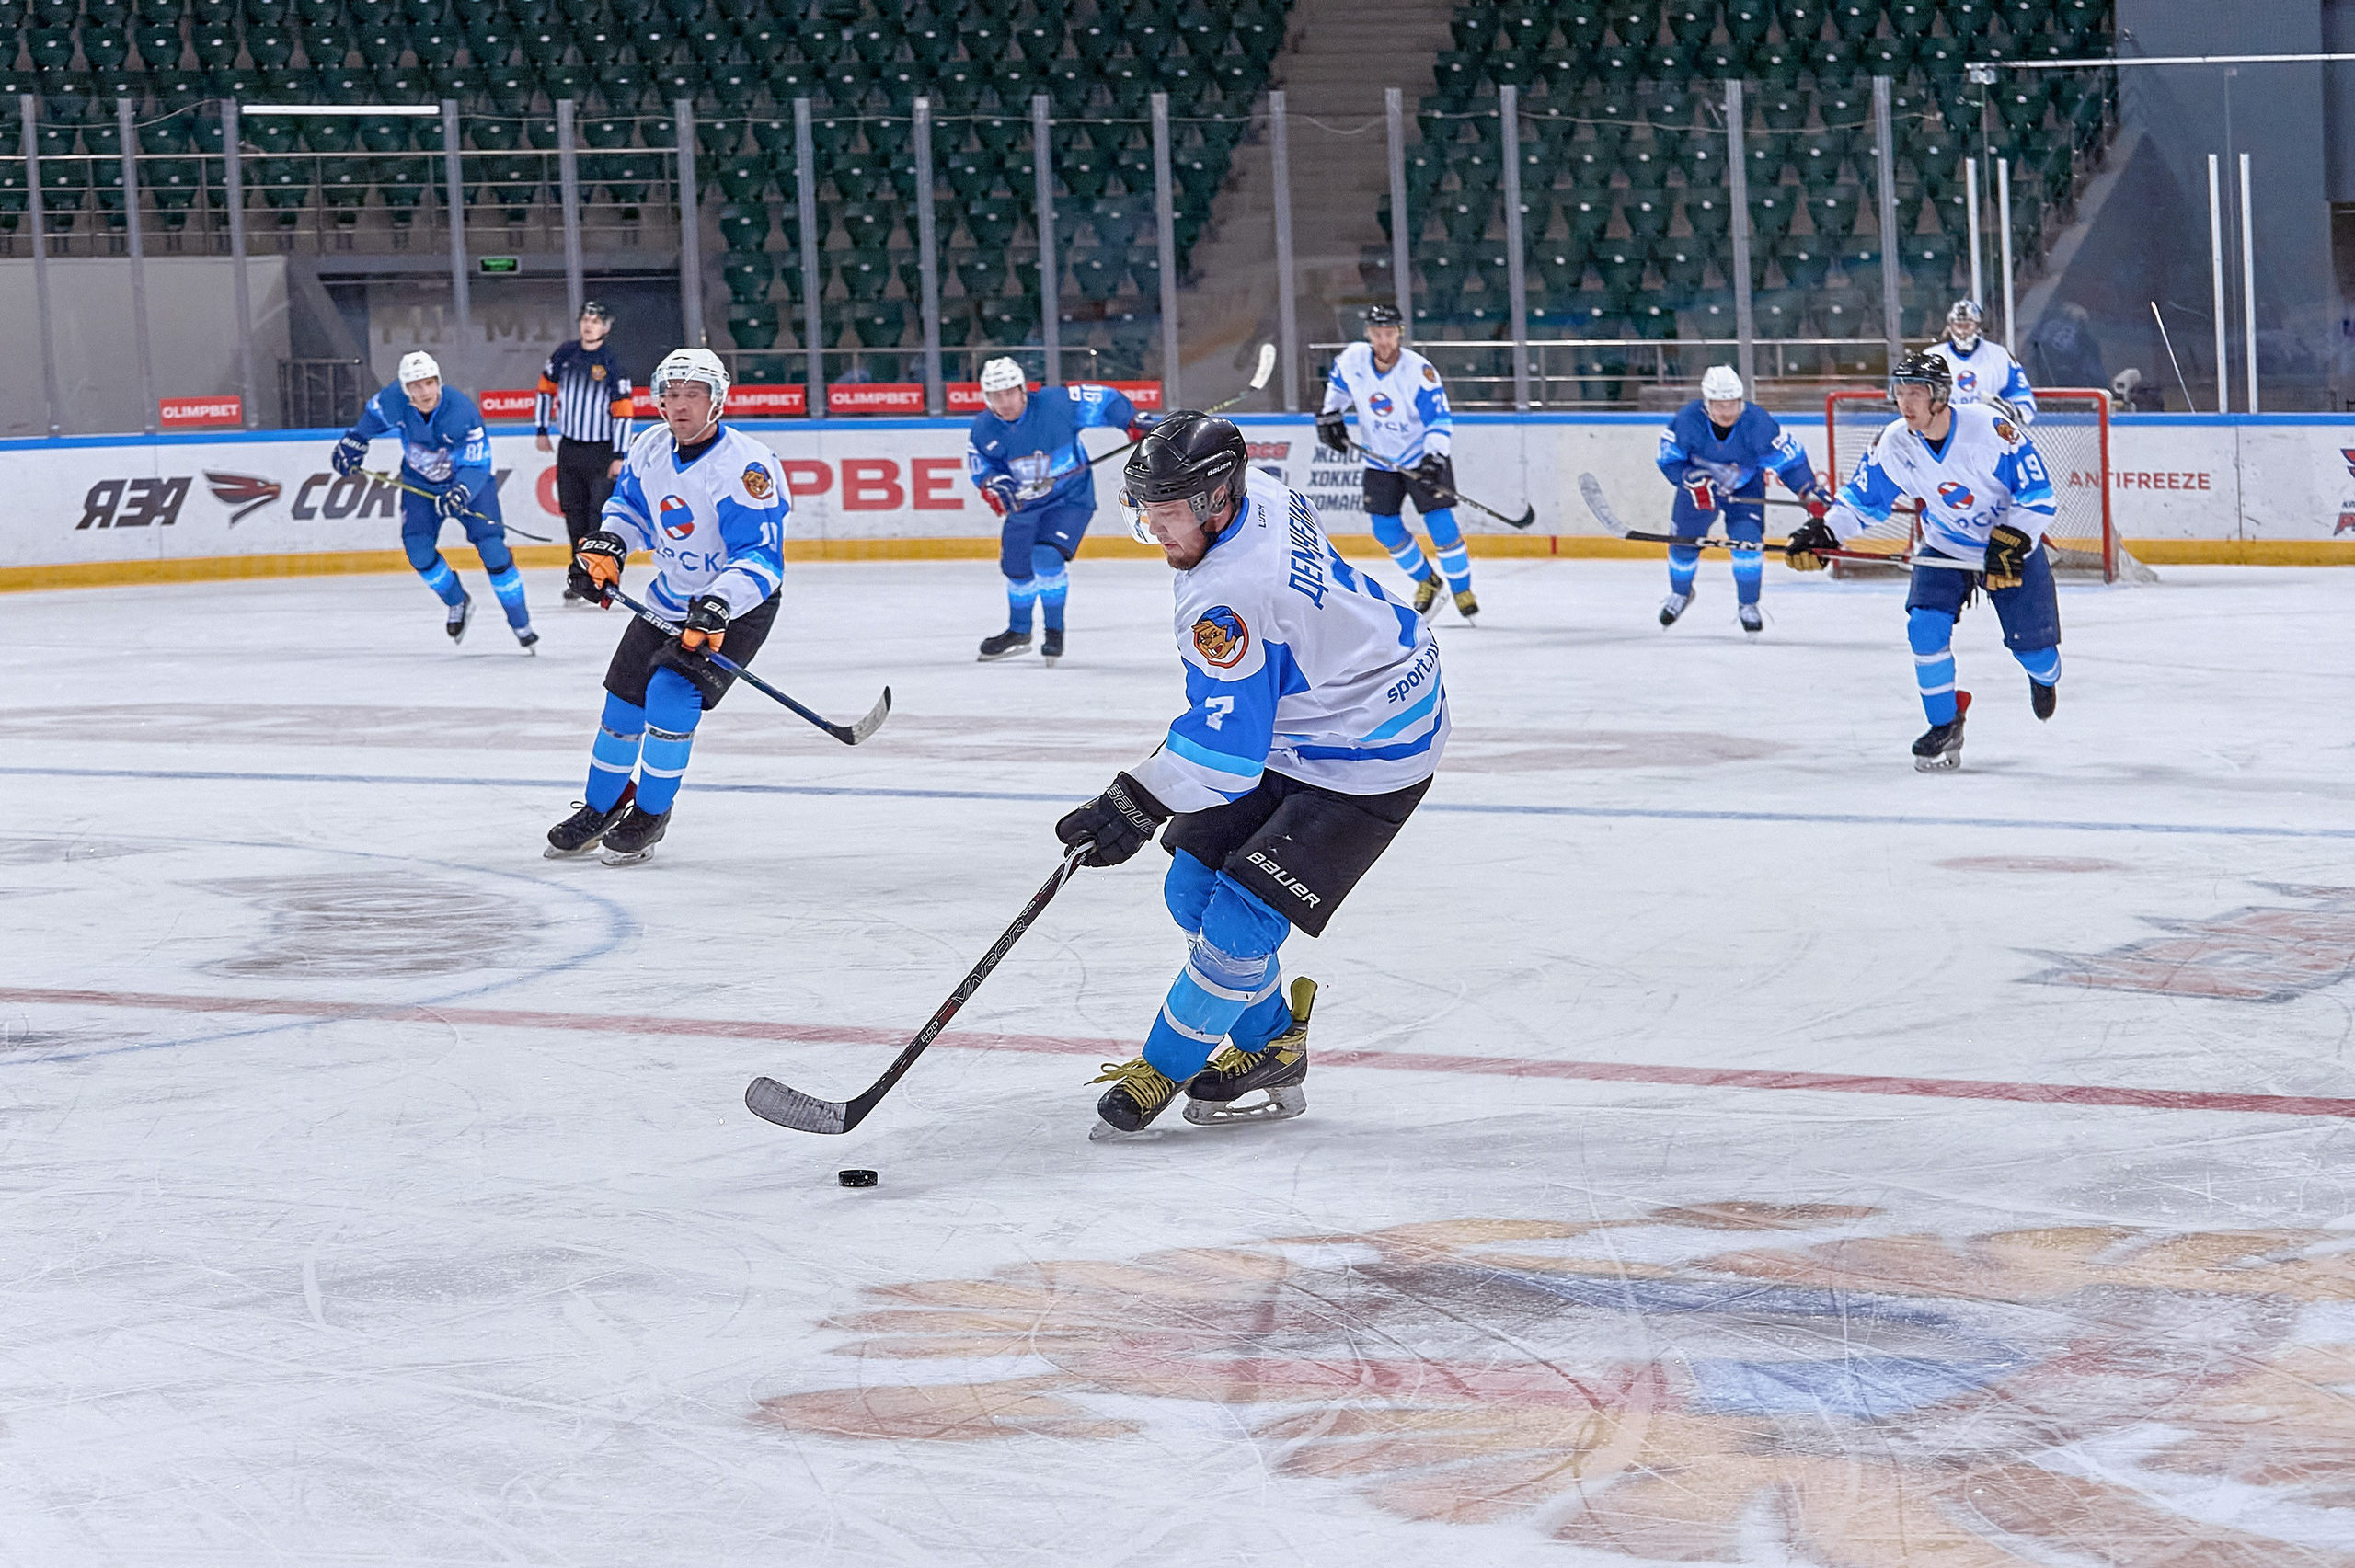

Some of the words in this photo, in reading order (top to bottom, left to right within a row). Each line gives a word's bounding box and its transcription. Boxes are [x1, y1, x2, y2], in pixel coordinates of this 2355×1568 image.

[482, 396, 535, 411] OLIMP
[724, 391, 802, 408] LIMPBET
[830, 391, 920, 406] OLIMPBET
[162, 404, 239, 419] OLIMPBET
[1207, 461, 1232, 477] BAUER
[1308, 470, 1365, 487] ХОККЕ
[580, 538, 626, 557] BAU
[656, 544, 724, 574] РСК
[1205, 695, 1235, 731] 7
[1106, 783, 1157, 834] BAUE
[1246, 851, 1322, 909] BAUER
